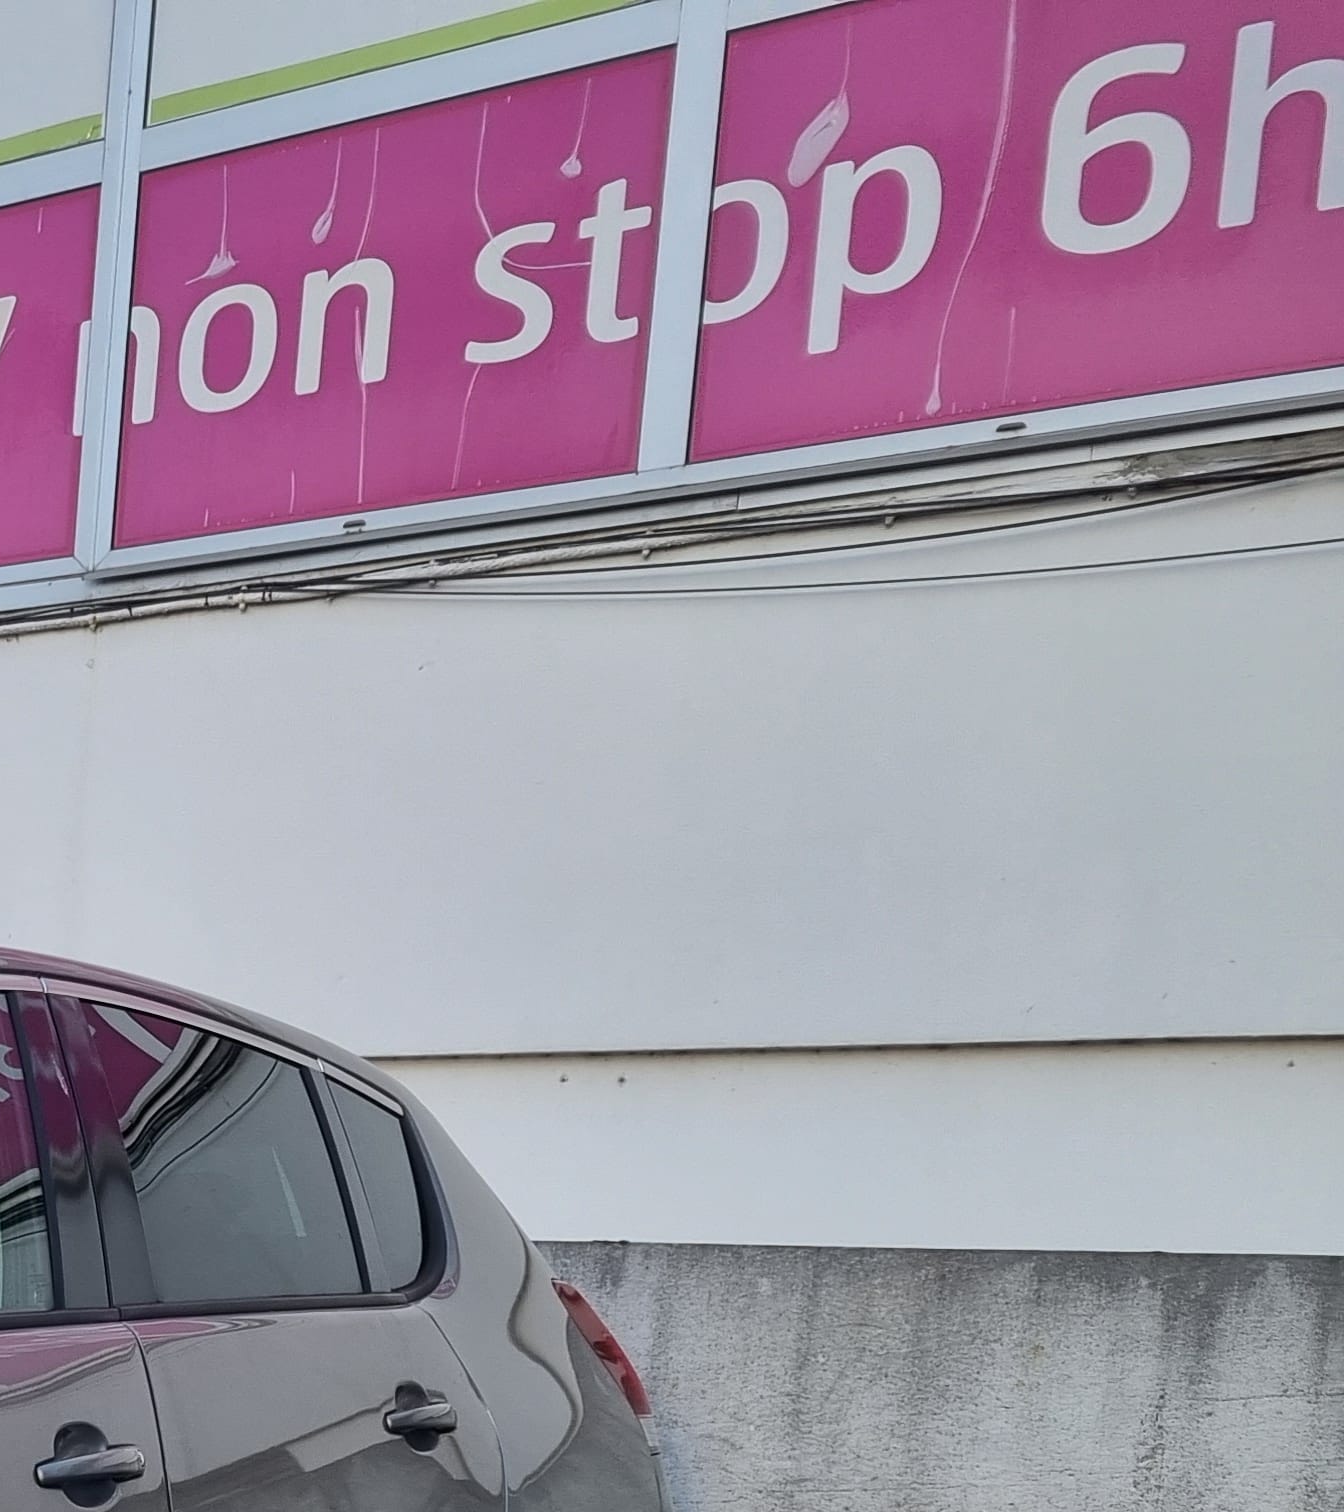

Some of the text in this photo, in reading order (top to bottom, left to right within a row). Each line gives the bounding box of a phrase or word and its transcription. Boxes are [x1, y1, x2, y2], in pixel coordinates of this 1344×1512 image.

[72, 258, 395, 436] non
[464, 145, 943, 363] stop
[1042, 20, 1344, 254] 6h
